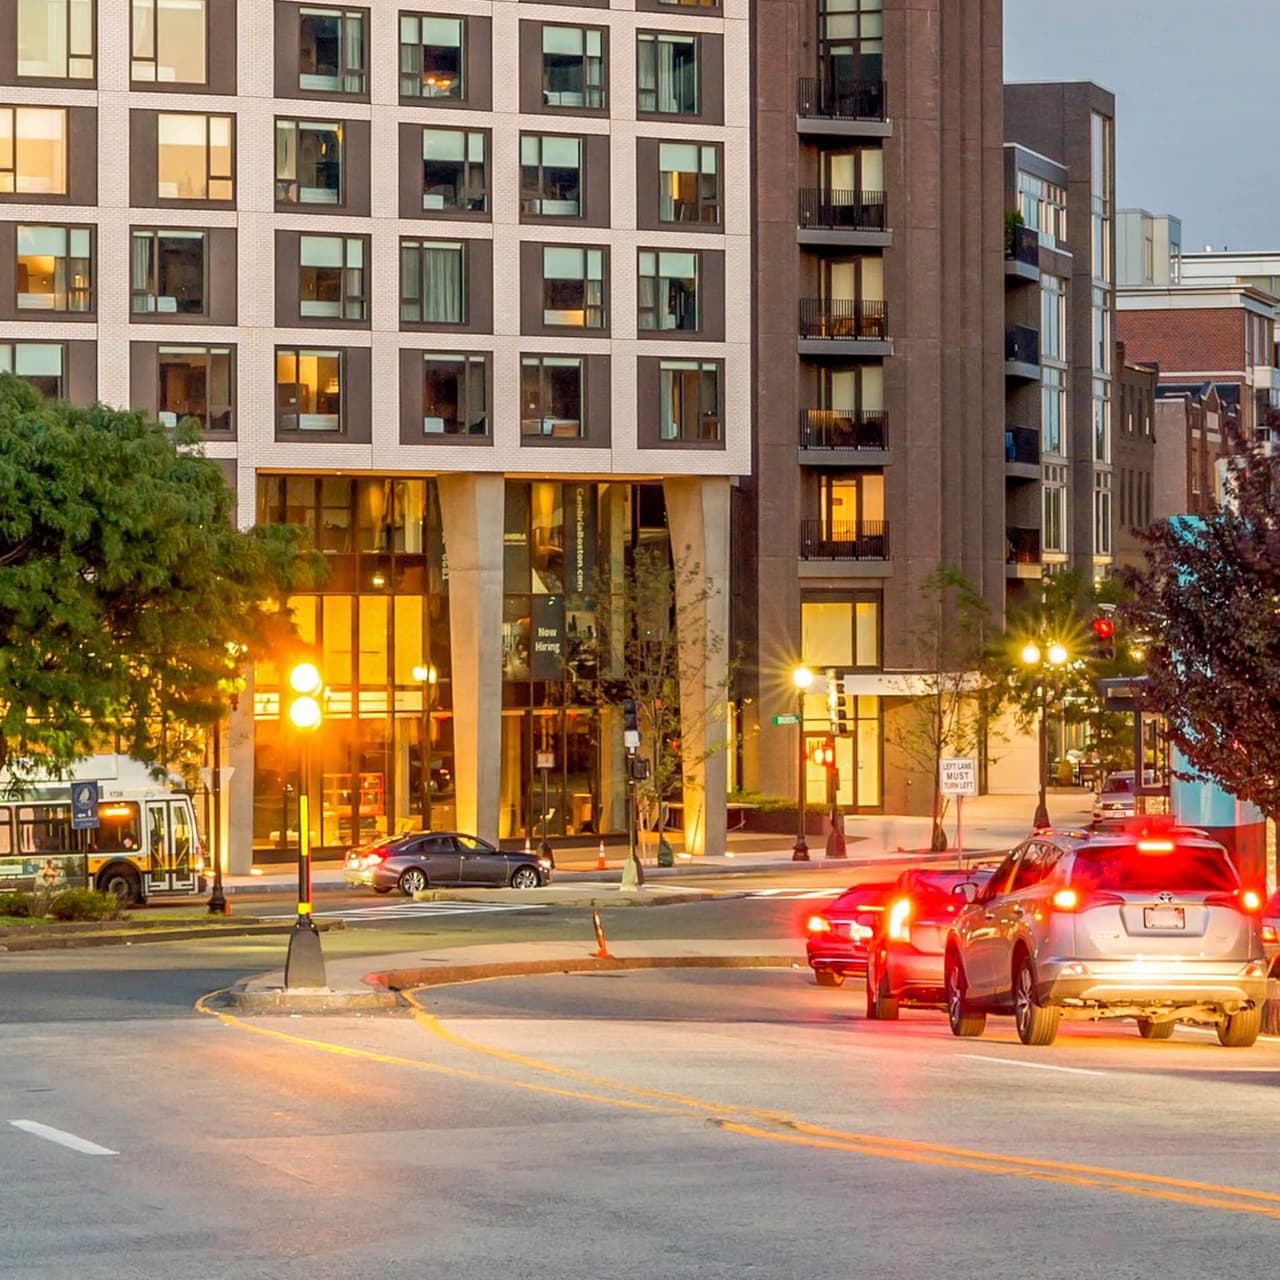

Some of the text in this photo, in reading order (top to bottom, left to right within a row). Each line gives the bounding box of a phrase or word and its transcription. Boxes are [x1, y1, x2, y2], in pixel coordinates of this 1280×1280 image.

[538, 627, 557, 637] Now
[535, 641, 560, 654] Hiring
[943, 762, 972, 770] LEFT LANE
[946, 771, 969, 780] MUST
[960, 781, 973, 789] LEFT
